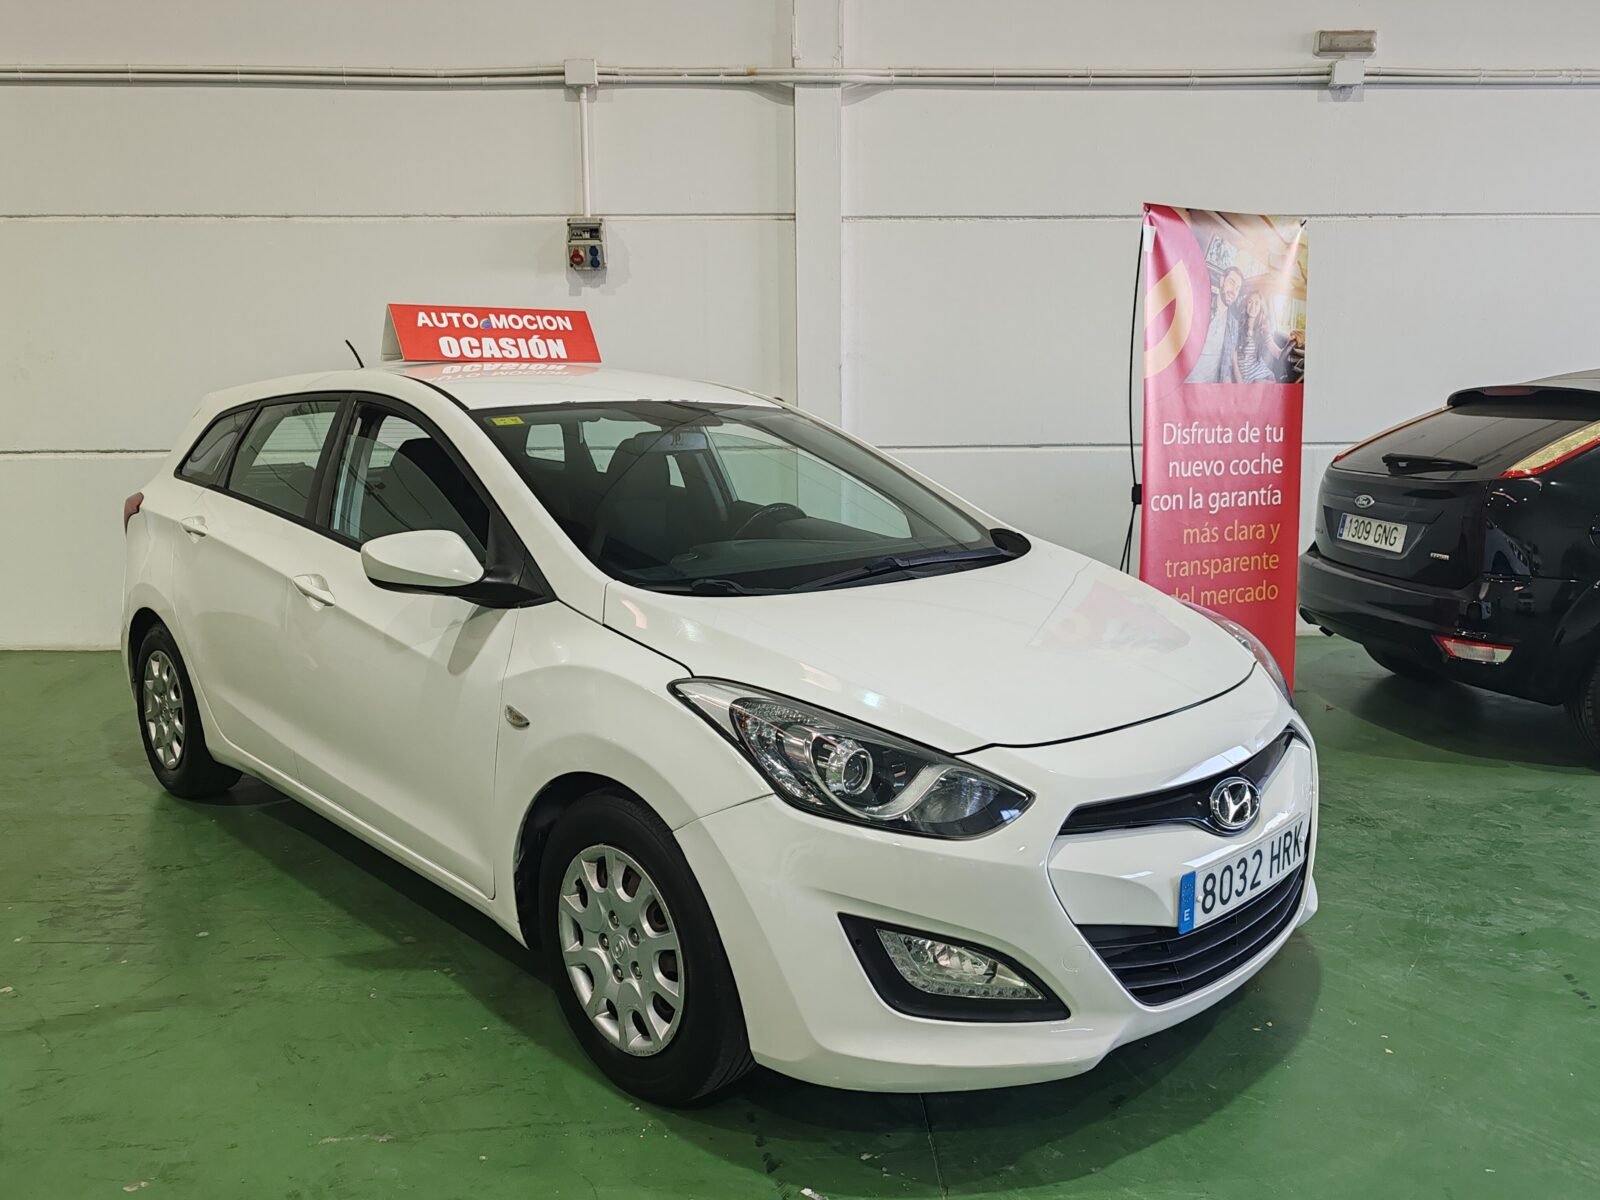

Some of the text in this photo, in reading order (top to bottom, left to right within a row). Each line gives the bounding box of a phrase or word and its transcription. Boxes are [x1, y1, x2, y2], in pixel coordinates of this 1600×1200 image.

[416, 311, 573, 331] AUTO MOCION
[438, 335, 568, 359] OCASIÓN
[1162, 421, 1284, 445] Disfruta de tu
[1168, 452, 1283, 478] nuevo coche
[1150, 484, 1282, 514] con la garantía
[1183, 520, 1281, 544] más clara y
[1347, 518, 1399, 547] 1309 GNG
[1165, 552, 1279, 579] transparente
[1200, 580, 1279, 607] mercado
[1201, 820, 1303, 914] 8032 HRK
[1183, 908, 1191, 921] E
